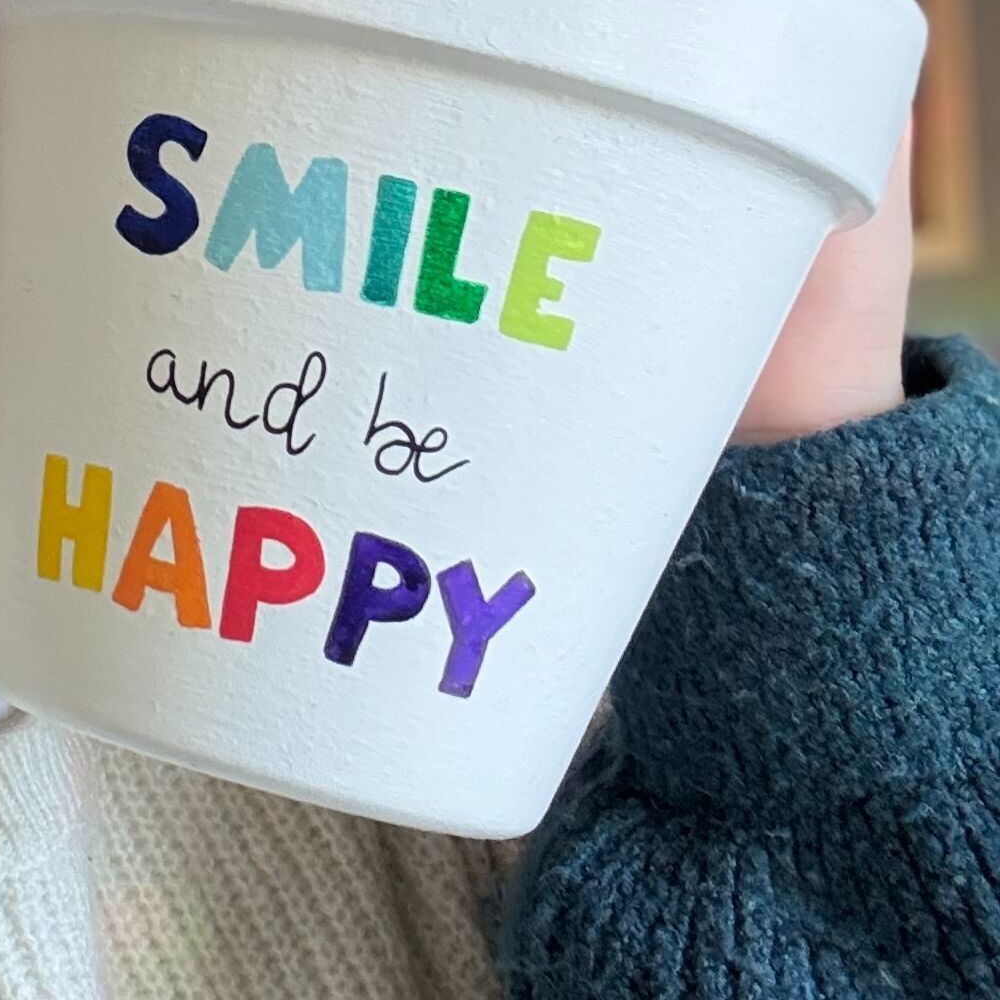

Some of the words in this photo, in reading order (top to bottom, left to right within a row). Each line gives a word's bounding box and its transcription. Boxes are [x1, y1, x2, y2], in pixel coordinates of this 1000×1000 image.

[115, 113, 602, 351] SMILE
[146, 348, 327, 455] and
[364, 372, 470, 482] be
[36, 453, 536, 699] HAPPY
